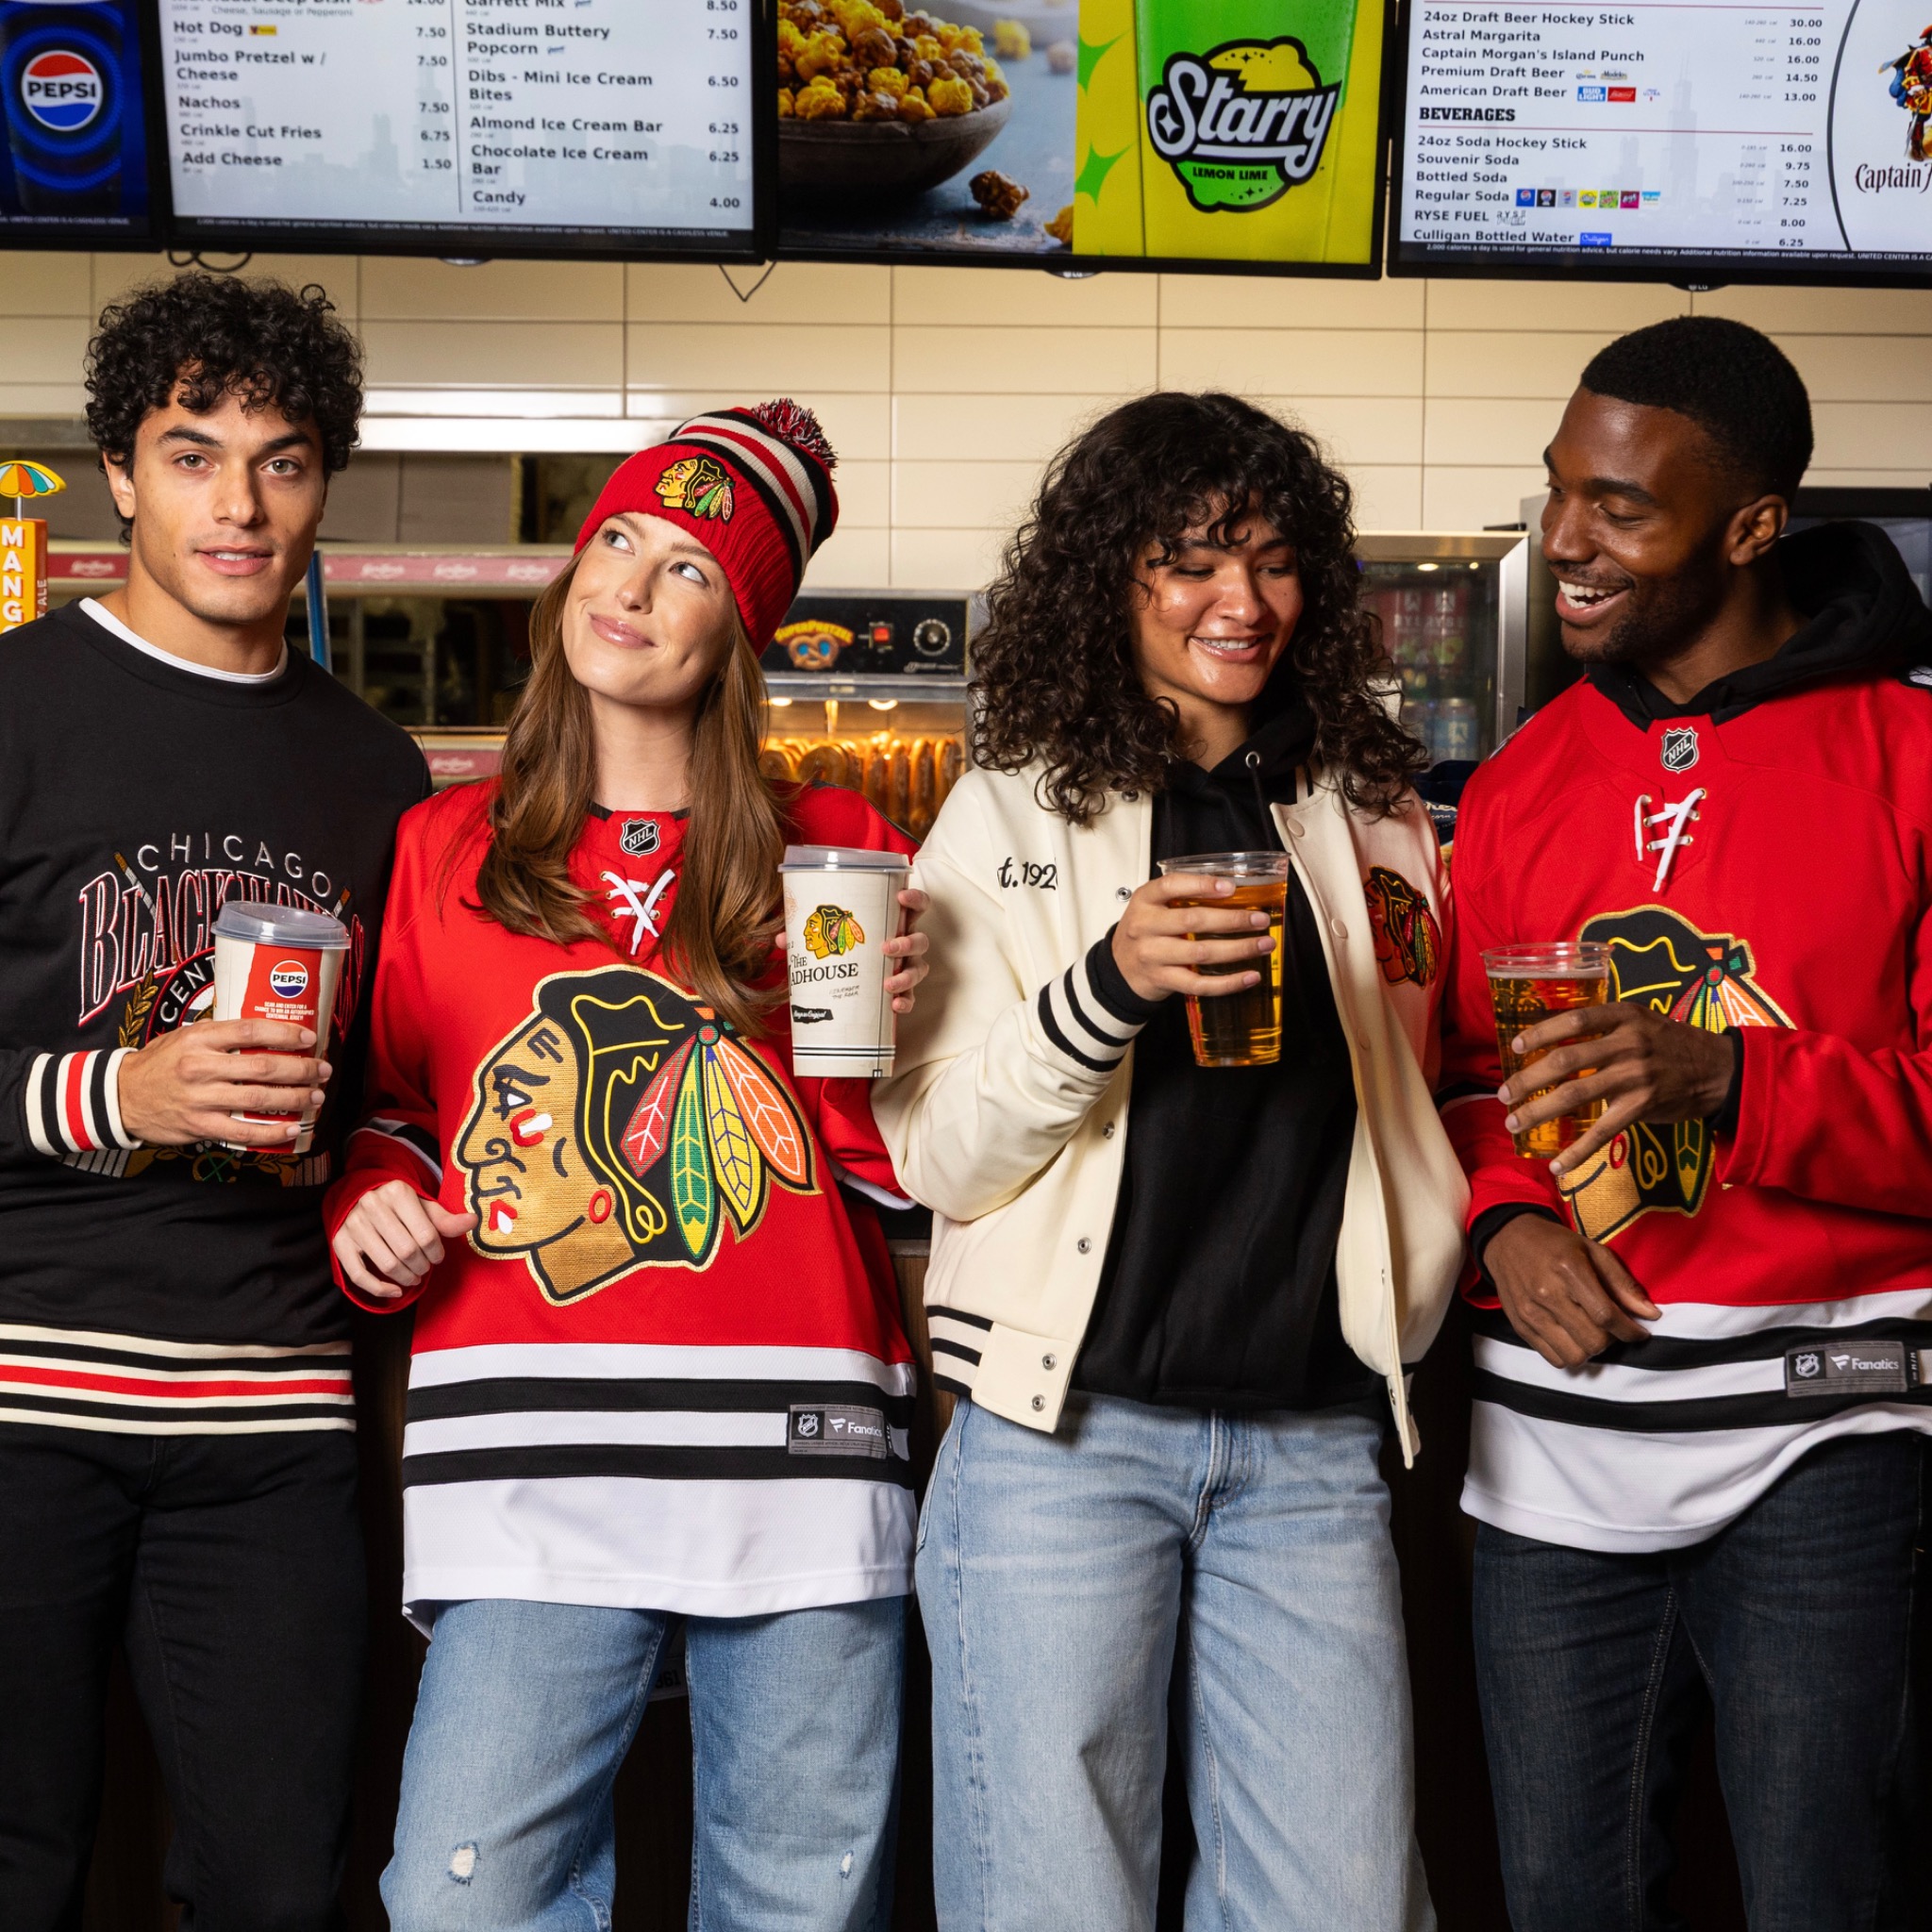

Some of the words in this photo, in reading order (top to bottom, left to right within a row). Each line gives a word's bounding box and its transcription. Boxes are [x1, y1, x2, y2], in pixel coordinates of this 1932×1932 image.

[707, 1, 738, 11] 8.50
[1424, 11, 1457, 23] 24oz
[1462, 12, 1499, 24] Draft
[1505, 13, 1538, 25] Beer
[1542, 14, 1593, 25] Hockey
[1599, 13, 1634, 25] Stick
[1790, 19, 1823, 27] 30.00
[174, 21, 203, 34] Hot
[209, 22, 242, 36] Dog
[416, 27, 446, 38] 7.50
[467, 23, 539, 36] Stadium
[544, 25, 610, 40] Buttery
[708, 29, 738, 40] 7.50
[1423, 29, 1465, 41] Astral
[1470, 31, 1541, 42] Margarita
[1789, 37, 1822, 46] 16.00
[467, 42, 539, 56] Popcorn
[1422, 48, 1477, 61] Captain
[1482, 49, 1547, 62] Morgan's
[1553, 50, 1595, 61] Island
[1601, 51, 1644, 62] Punch
[1788, 56, 1820, 64] 16.00
[175, 50, 228, 64] Jumbo
[235, 51, 295, 64] Pretzel
[302, 55, 314, 64] w
[417, 56, 447, 67] 7.50
[176, 68, 238, 81] Cheese
[468, 70, 506, 83] Dibs
[524, 71, 560, 84] Mini
[567, 73, 591, 85] Ice
[596, 73, 653, 86] Cream
[708, 76, 739, 88] 6.50
[1422, 66, 1485, 78] Premium
[1491, 67, 1526, 78] Draft
[1531, 67, 1565, 78] Beer
[1786, 74, 1819, 83] 14.50
[27, 81, 96, 99] PEPSI
[469, 88, 512, 101] Bites
[1420, 85, 1487, 97] American
[1492, 86, 1528, 97] Draft
[1534, 87, 1567, 98] Beer
[1785, 92, 1816, 102] 13.00
[179, 96, 241, 108] Nachos
[419, 103, 449, 113] 7.50
[1149, 60, 1337, 178] Starry
[1419, 107, 1516, 122] BEVERAGES
[180, 124, 240, 138] Crinkle
[246, 125, 275, 139] Cut
[281, 126, 322, 140] Fries
[421, 131, 450, 142] 6.75
[470, 116, 535, 130] Almond
[541, 118, 566, 131] Ice
[572, 118, 627, 132] Cream
[633, 120, 663, 133] Bar
[708, 124, 739, 135] 6.25
[472, 144, 557, 158] Chocolate
[562, 146, 587, 159] Ice
[592, 147, 648, 161] Cream
[709, 151, 739, 162] 6.25
[1418, 136, 1451, 147] 24oz
[1456, 136, 1491, 147] Soda
[1496, 137, 1547, 150] Hockey
[1552, 138, 1587, 149] Stick
[1780, 144, 1812, 153] 16.00
[182, 152, 215, 165] Add
[221, 153, 282, 166] Cheese
[423, 158, 451, 170] 1.50
[473, 162, 502, 175] Bar
[1417, 154, 1480, 165] Souvenir
[1485, 154, 1520, 166] Soda
[1786, 162, 1810, 171] 9.75
[1192, 166, 1235, 180] LEMON
[1239, 169, 1268, 181] LIME
[1416, 171, 1469, 183] Bottled
[1473, 172, 1507, 183] Soda
[1784, 179, 1809, 189] 7.50
[1855, 163, 1921, 193] Captain
[473, 190, 525, 206] Candy
[709, 198, 741, 208] 4.00
[1415, 191, 1470, 203] Regular
[1474, 191, 1509, 203] Soda
[1783, 197, 1807, 206] 7.25
[1414, 210, 1450, 222] RYSE
[1455, 211, 1489, 222] FUEL
[1780, 219, 1806, 227] 8.00
[1413, 229, 1471, 243] Culligan
[1475, 230, 1526, 242] Bottled
[1531, 231, 1574, 243] Water
[1779, 239, 1804, 247] 6.25
[2, 525, 24, 633] MANG
[37, 579, 47, 607] ALE
[1669, 739, 1690, 763] NHL
[629, 827, 653, 848] NHL
[138, 833, 330, 897] CHICAGO
[997, 857, 1058, 891] t.192
[791, 953, 808, 969] THE
[273, 974, 306, 984] PEPSI
[1852, 1357, 1899, 1371] Fanatics
[847, 1422, 883, 1438] Fanatics
